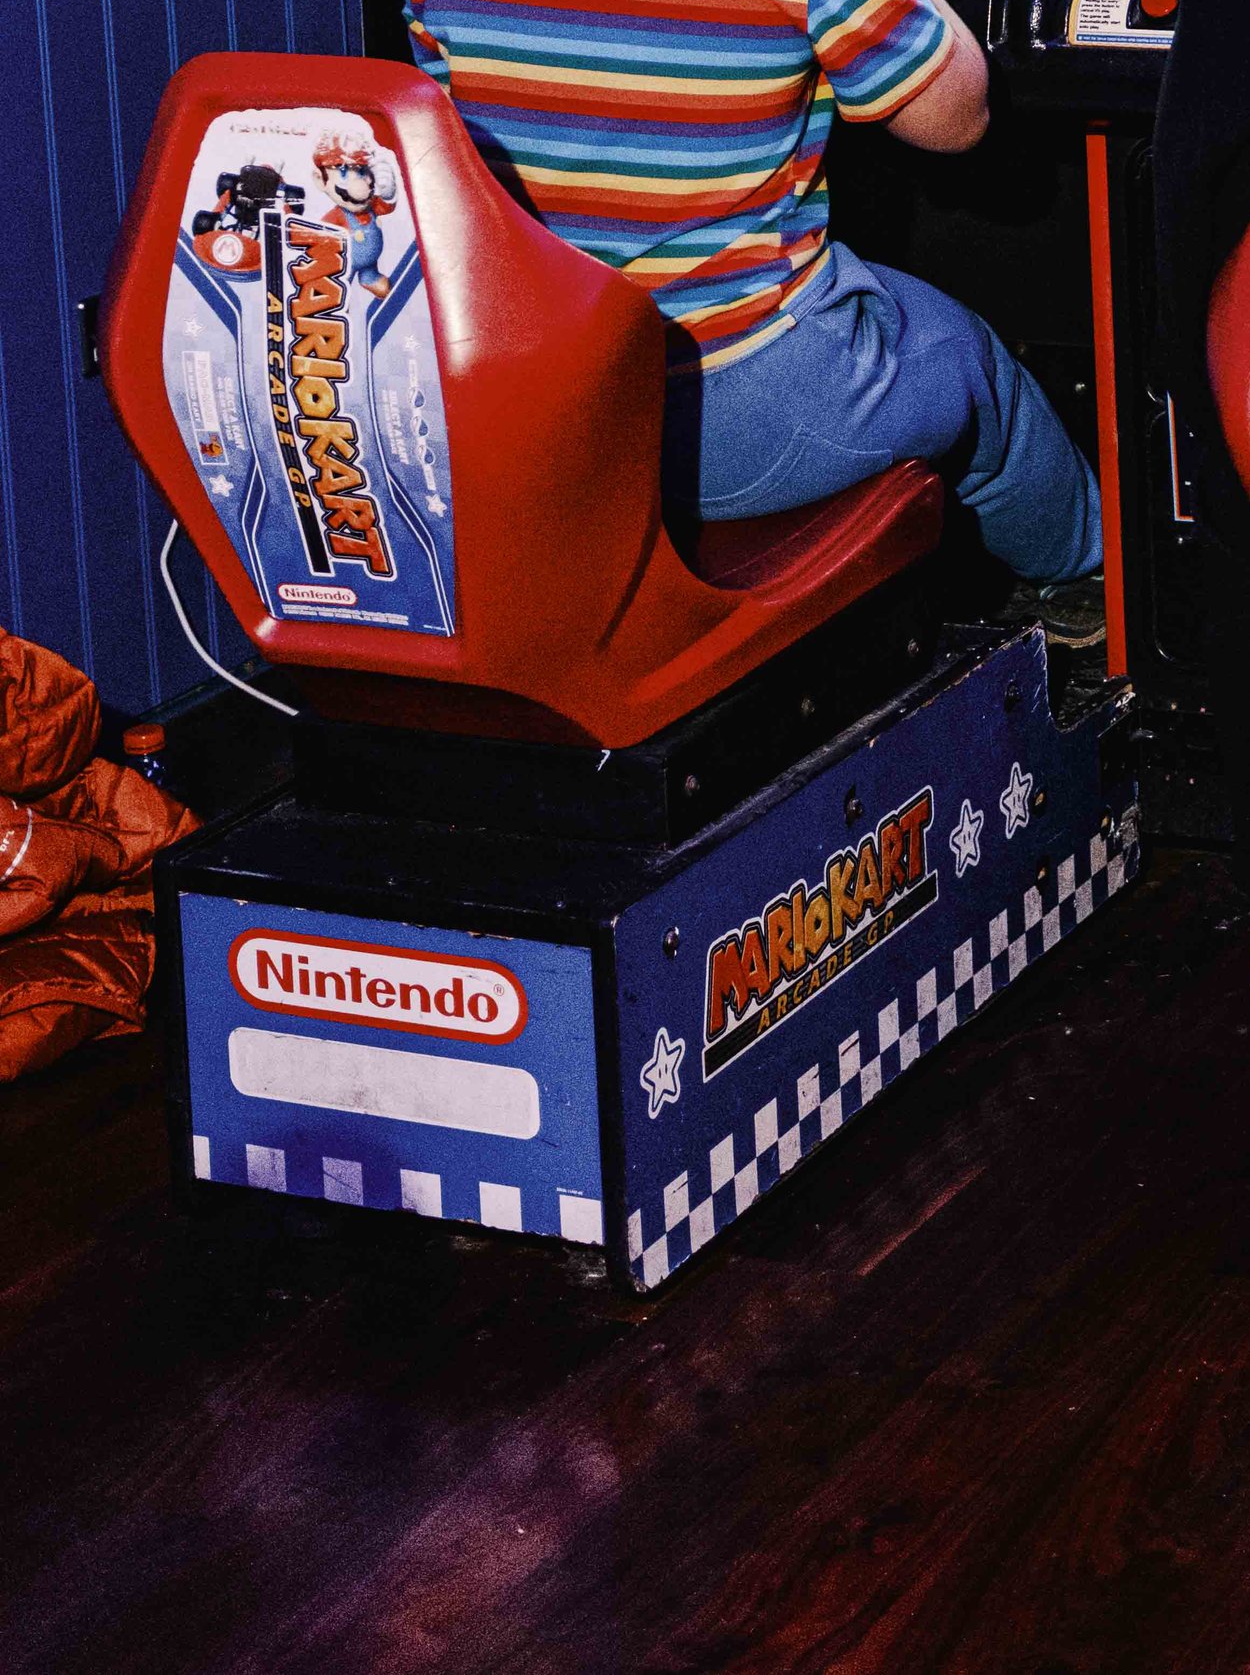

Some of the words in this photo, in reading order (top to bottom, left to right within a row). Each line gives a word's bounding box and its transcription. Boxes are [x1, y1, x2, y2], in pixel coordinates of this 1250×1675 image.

[266, 291, 296, 460] ARCADE
[284, 588, 351, 602] Nintendo
[255, 948, 500, 1024] Nintendo
[757, 943, 853, 1036] ARCADE
